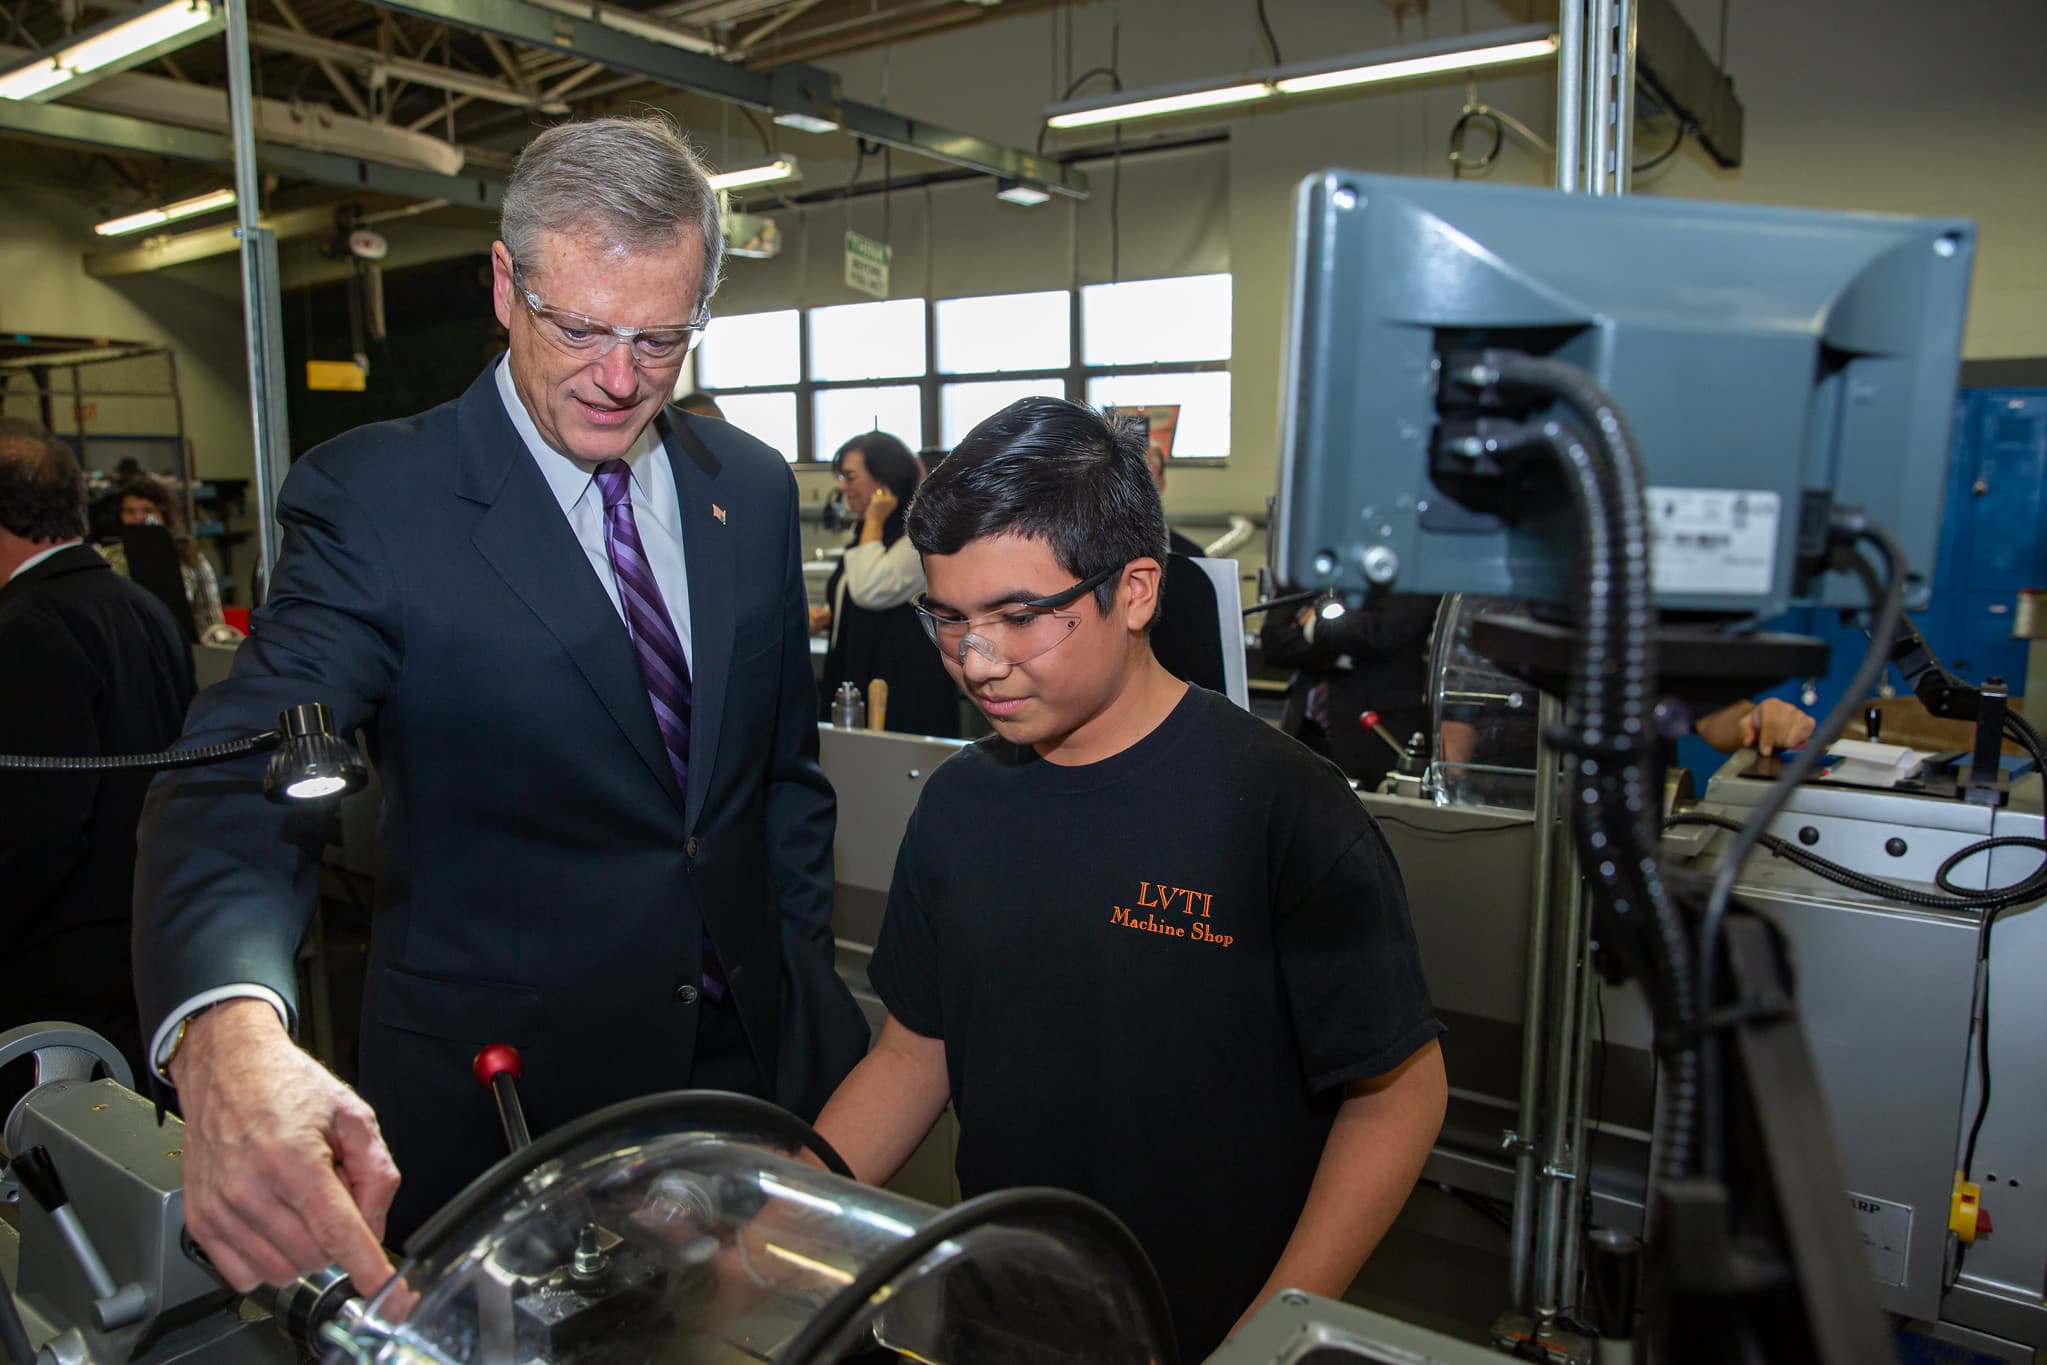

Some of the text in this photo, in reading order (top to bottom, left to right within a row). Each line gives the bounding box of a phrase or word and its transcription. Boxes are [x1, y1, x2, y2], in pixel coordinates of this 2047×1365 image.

[1136, 881, 1214, 919] LVTI
[1109, 905, 1235, 948] Machine Shop
